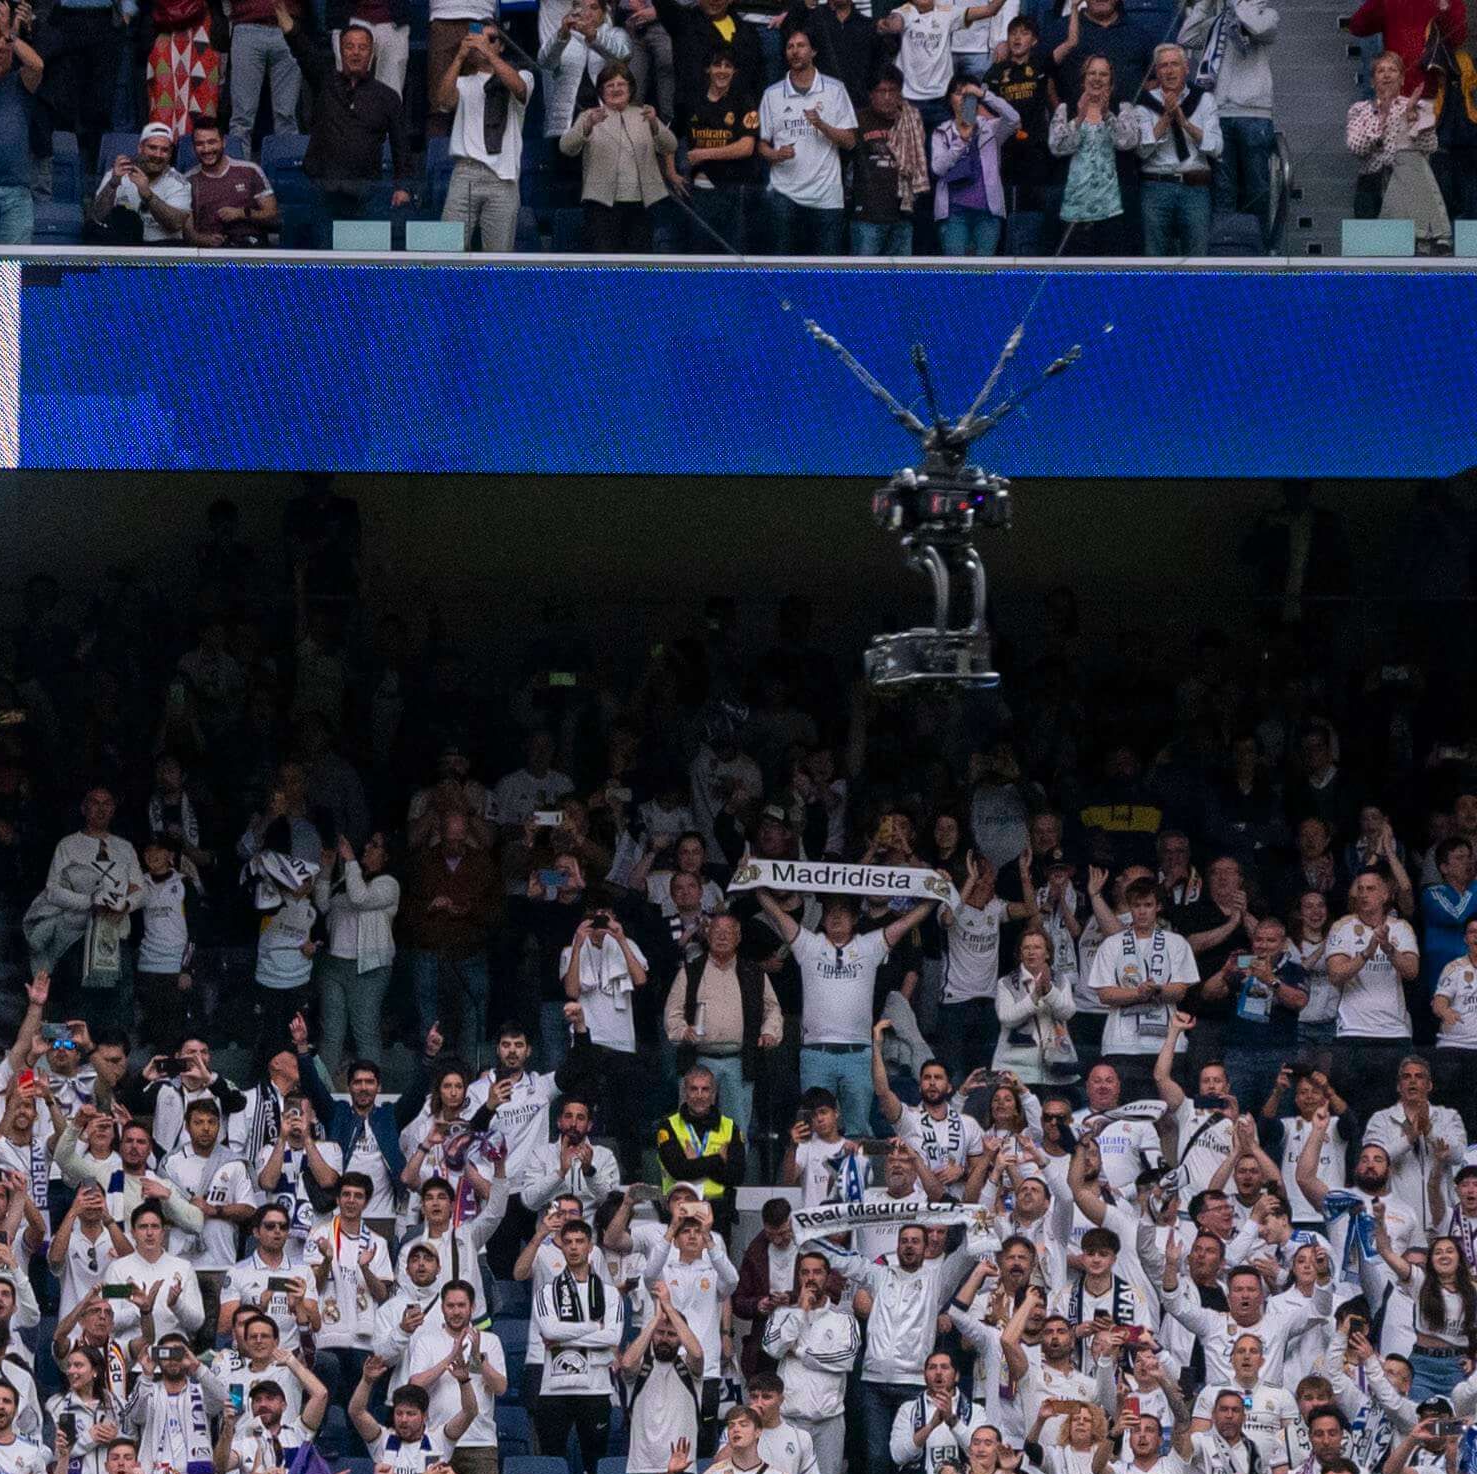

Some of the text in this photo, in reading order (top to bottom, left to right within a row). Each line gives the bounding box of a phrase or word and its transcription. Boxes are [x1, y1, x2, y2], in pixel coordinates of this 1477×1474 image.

[691, 128, 732, 139] Emirates
[770, 862, 912, 890] Madridista
[1122, 925, 1137, 955] REA
[496, 1103, 542, 1119] Emirates
[921, 1111, 938, 1161] REA
[1098, 1134, 1132, 1146] mirates
[1192, 1138, 1231, 1152] mirates
[29, 1142, 49, 1209] VEROS
[794, 1208, 842, 1228] Real
[847, 1197, 919, 1218] Madrid
